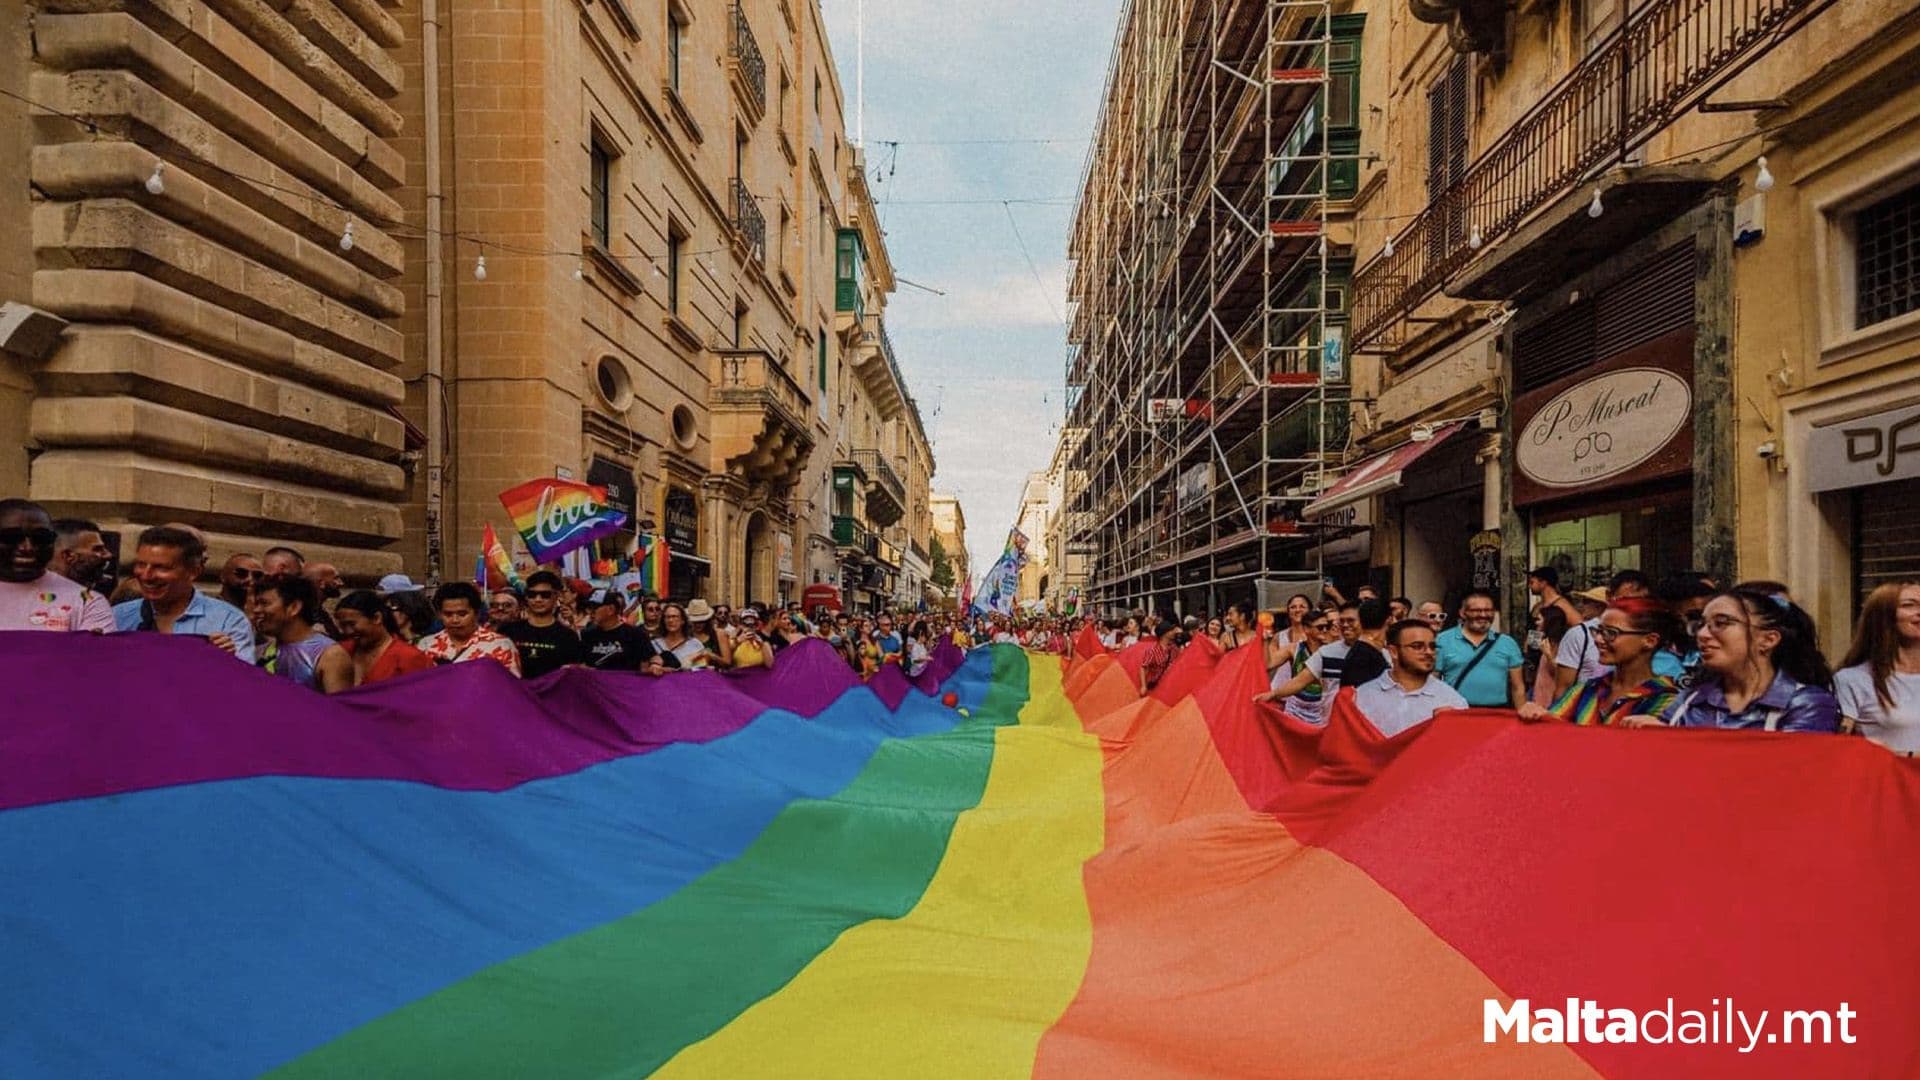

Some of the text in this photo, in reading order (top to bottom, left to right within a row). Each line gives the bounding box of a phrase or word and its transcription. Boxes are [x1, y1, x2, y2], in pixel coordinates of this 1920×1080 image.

[1533, 377, 1662, 446] P. Muscat
[526, 486, 599, 546] love
